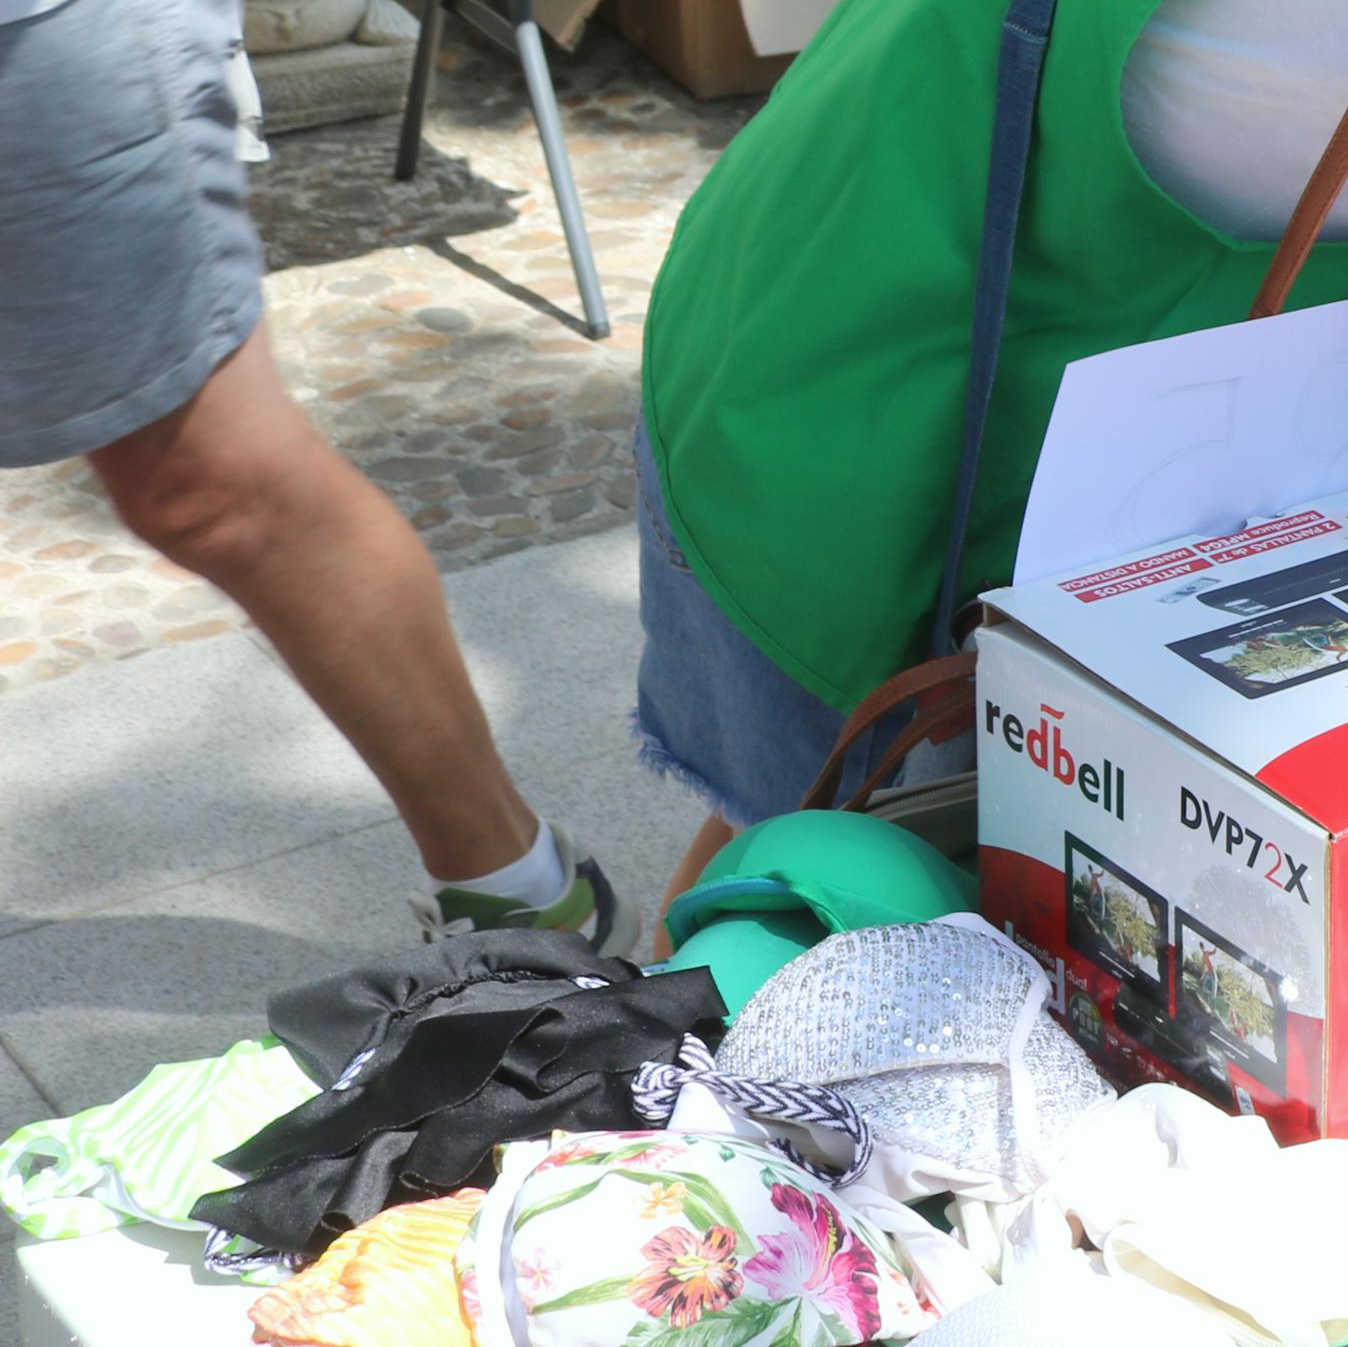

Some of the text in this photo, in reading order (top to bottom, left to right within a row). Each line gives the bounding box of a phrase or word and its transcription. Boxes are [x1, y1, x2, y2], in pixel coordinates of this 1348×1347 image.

[1250, 512, 1320, 536] Reproduce
[1250, 525, 1325, 552] PANTALLAS
[1322, 521, 1336, 530] 2
[1231, 546, 1249, 557] de
[1060, 549, 1189, 591] MANDO A DISTANCIA
[1093, 564, 1192, 597] ANTI-SALTOS
[985, 699, 1124, 821] redbell
[1180, 785, 1311, 906] DVP72X
